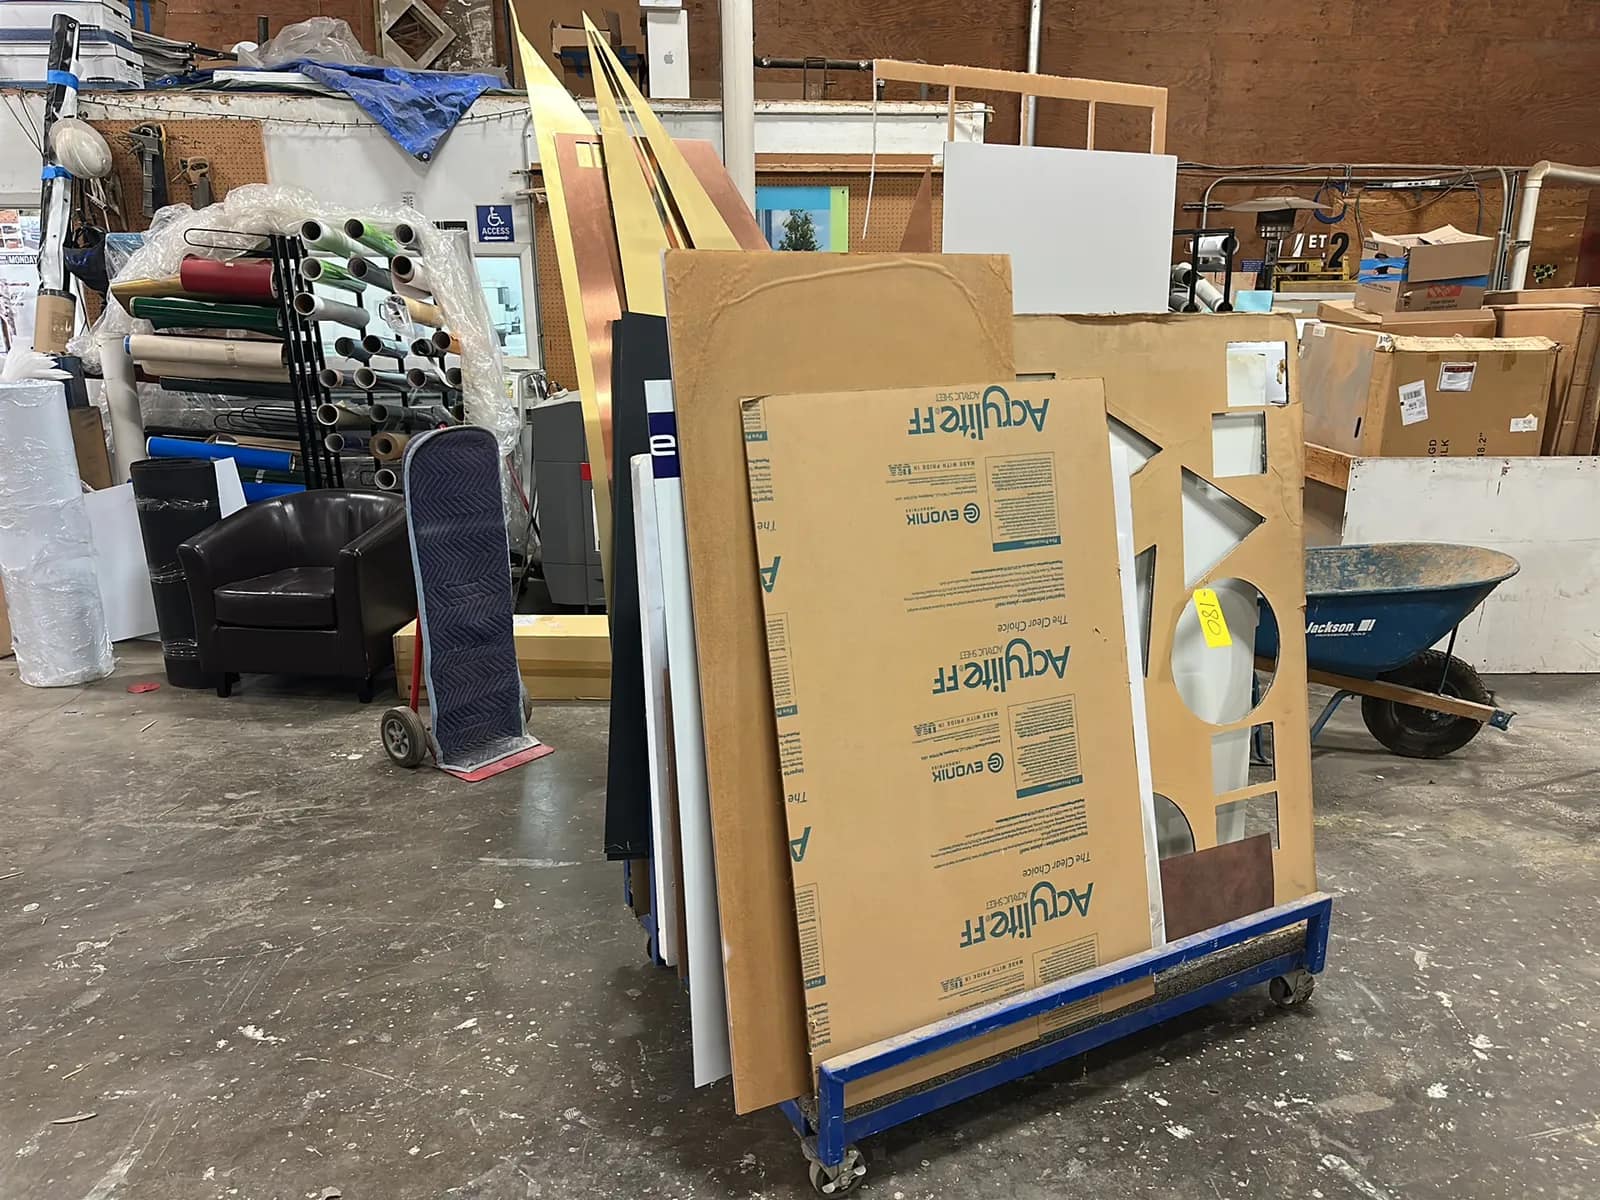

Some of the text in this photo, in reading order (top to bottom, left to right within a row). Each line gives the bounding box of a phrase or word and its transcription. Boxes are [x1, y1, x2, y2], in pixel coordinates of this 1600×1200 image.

[482, 227, 510, 235] ACCESS
[8, 255, 38, 264] MONDAY
[1328, 232, 1349, 268] 2
[908, 407, 935, 435] FF
[906, 508, 959, 525] EVONIK
[997, 615, 1068, 632] The Clear Choice
[1305, 621, 1354, 634] Jackson
[932, 664, 959, 695] FF
[931, 760, 983, 783] EVONIK
[788, 792, 807, 804] The
[1022, 851, 1091, 877] The Clear Choice
[960, 915, 986, 948] FF
